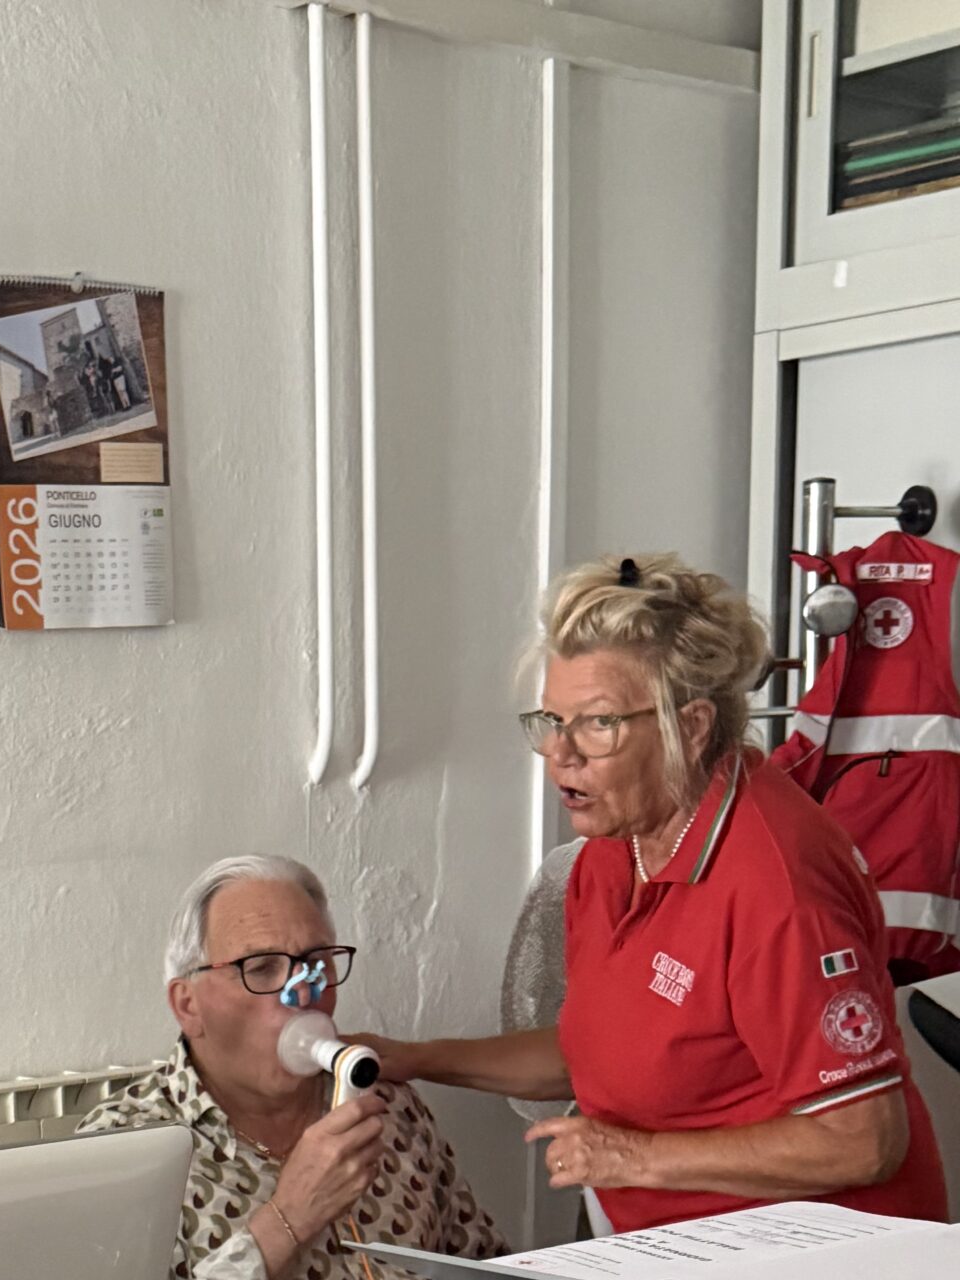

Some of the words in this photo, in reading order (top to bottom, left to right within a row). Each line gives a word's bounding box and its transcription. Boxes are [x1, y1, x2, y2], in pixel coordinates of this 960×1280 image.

[46, 491, 97, 501] PONTICELLO
[48, 514, 102, 529] GIUGNO
[6, 497, 44, 616] 2026
